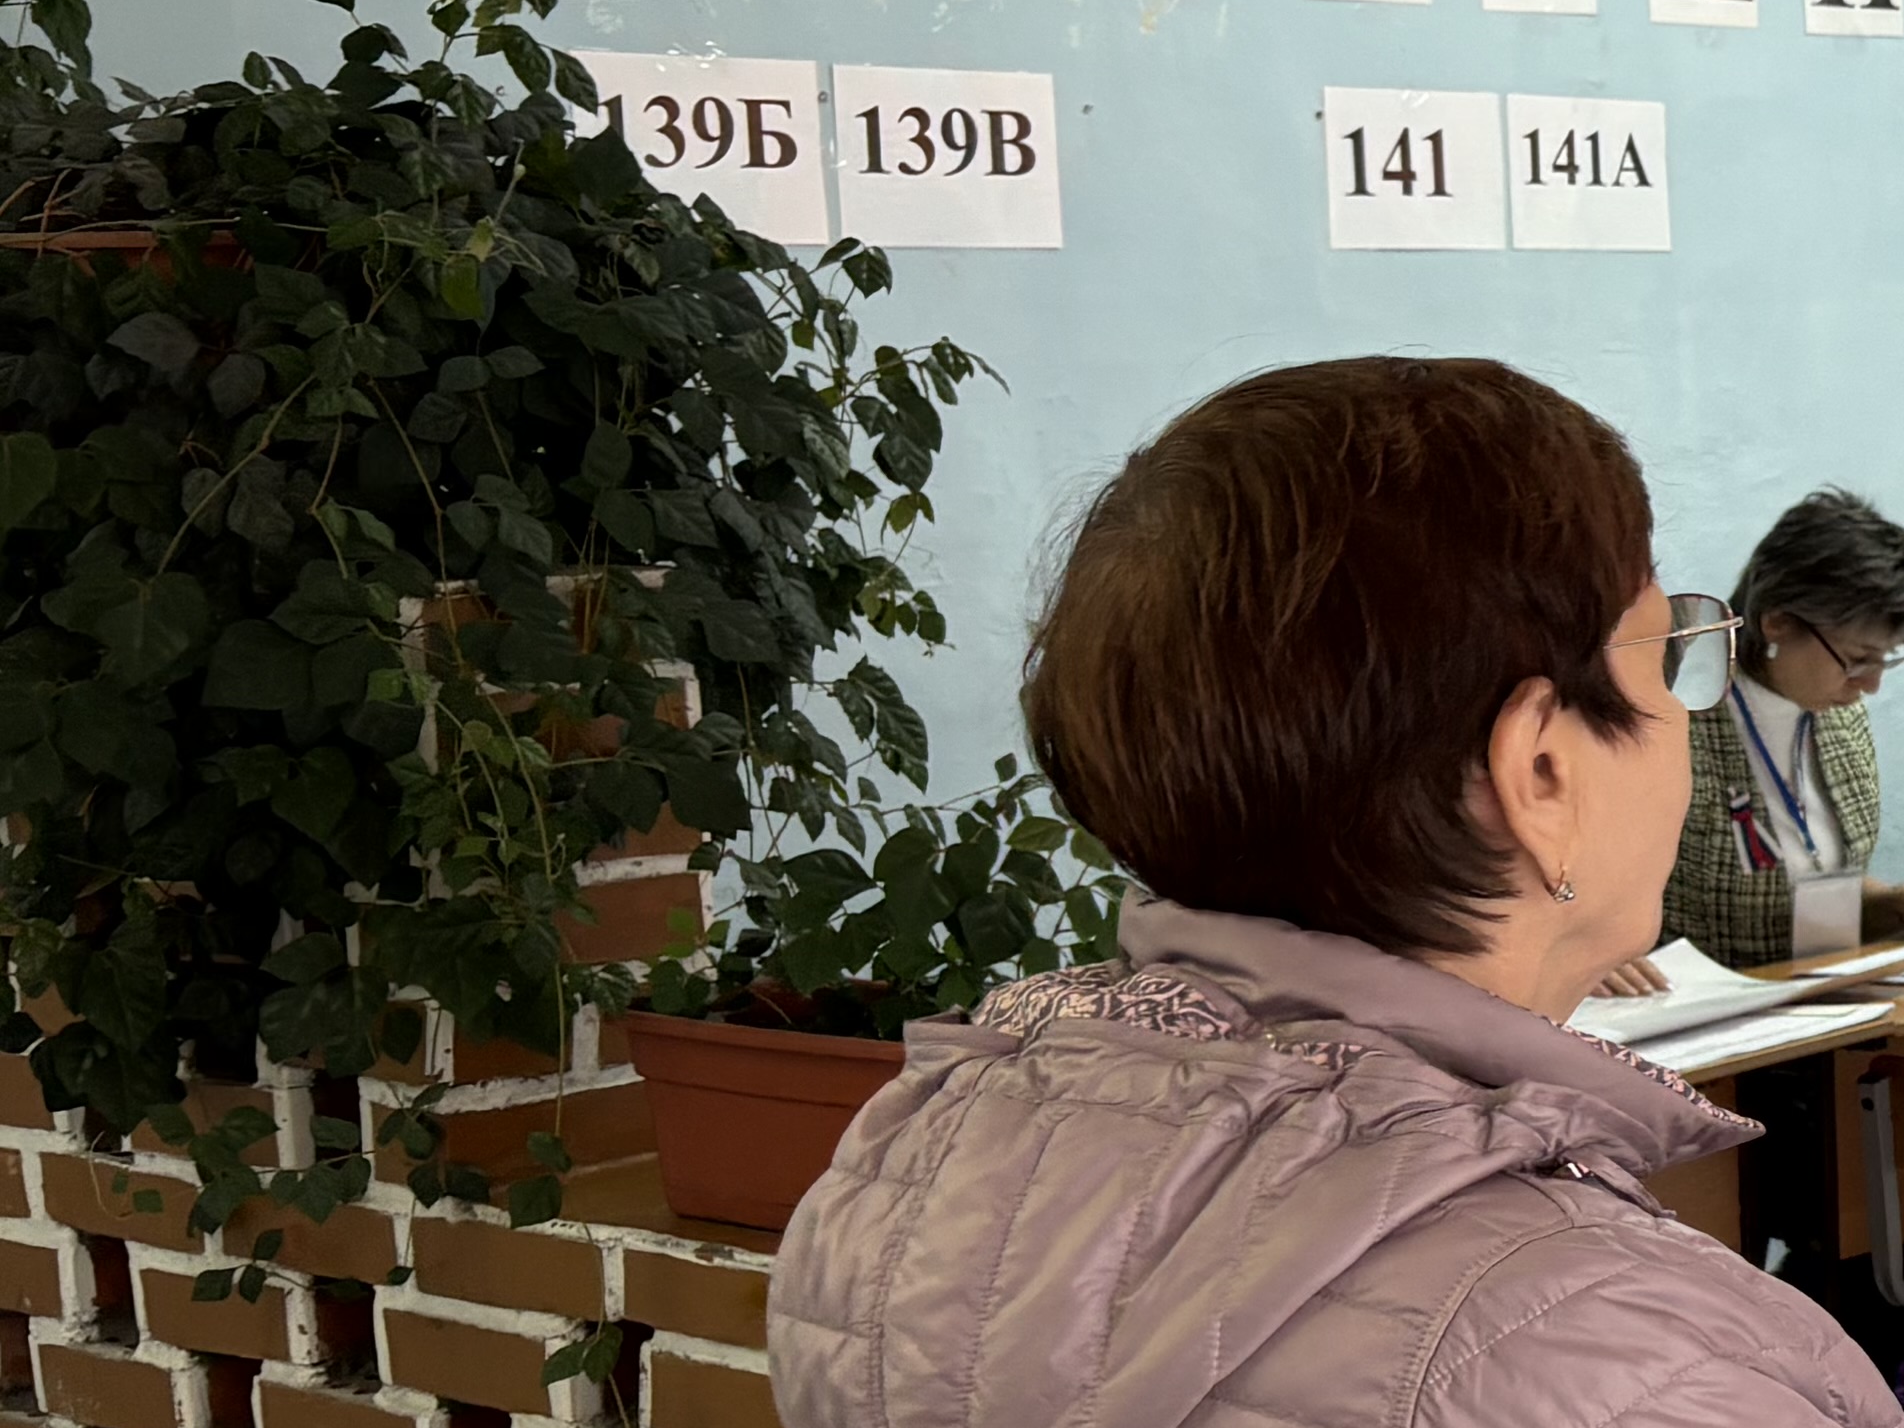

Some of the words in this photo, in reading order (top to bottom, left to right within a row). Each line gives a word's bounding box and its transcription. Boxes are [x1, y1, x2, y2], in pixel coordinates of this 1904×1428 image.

[855, 106, 1037, 177] 139В
[1342, 126, 1453, 197] 141
[1523, 129, 1653, 188] 141А
